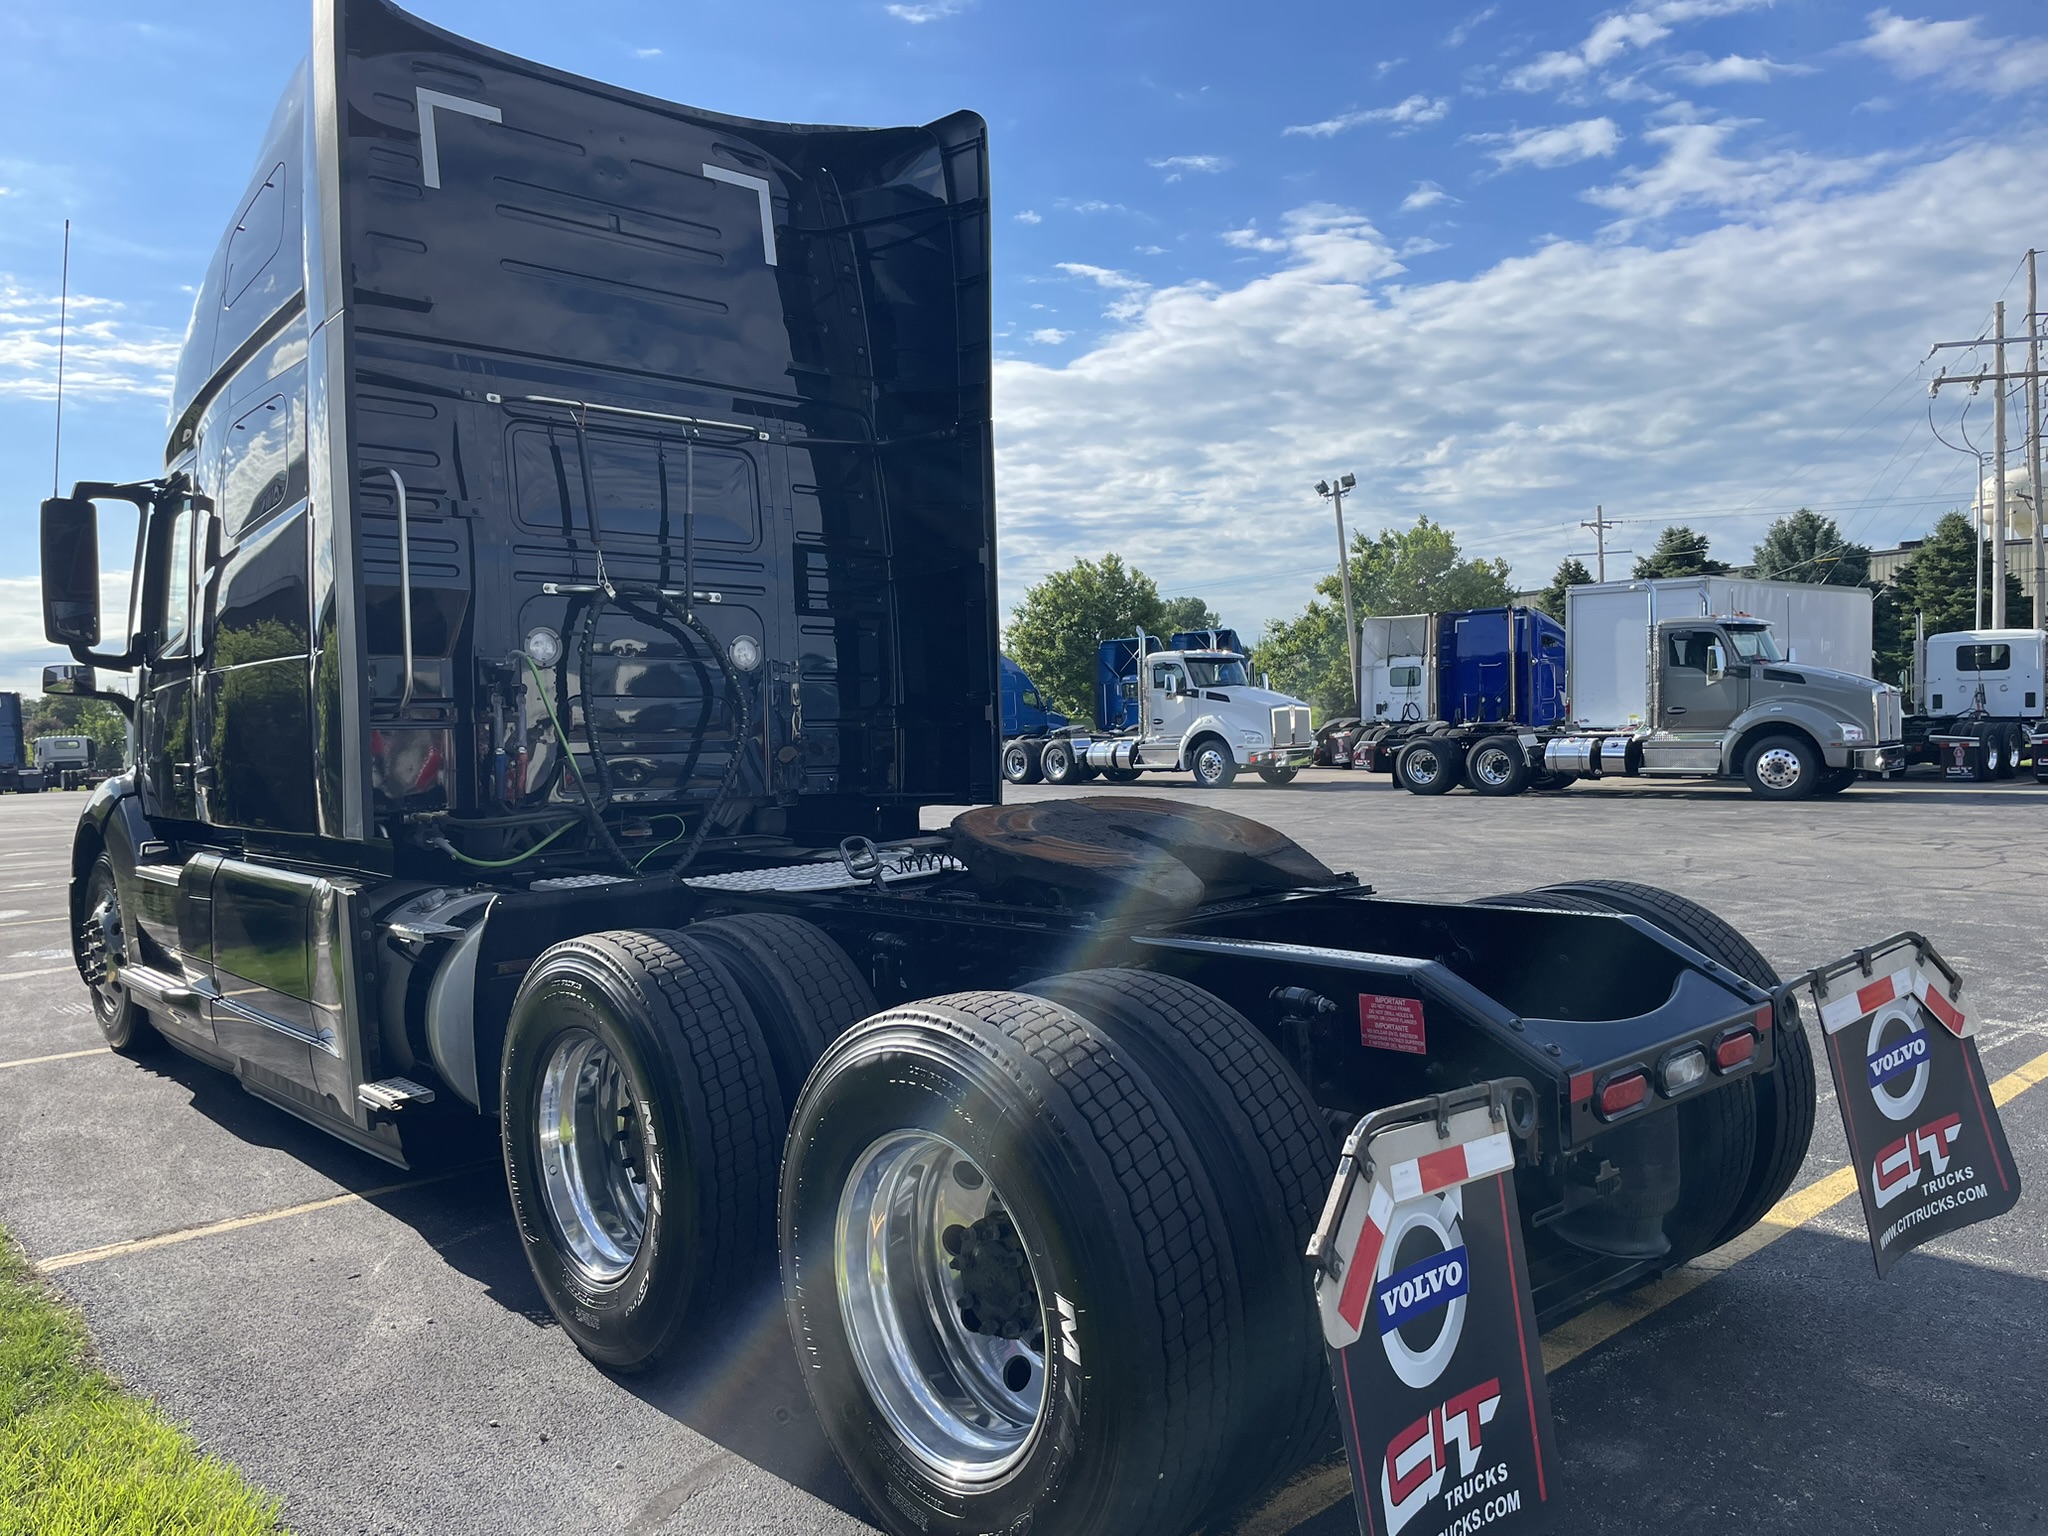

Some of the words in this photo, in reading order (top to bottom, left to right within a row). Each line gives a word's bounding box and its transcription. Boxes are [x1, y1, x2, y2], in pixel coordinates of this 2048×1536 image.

[1375, 997, 1405, 1006] IMPORTANT
[1375, 1022, 1409, 1032] IMPORTANTE
[1870, 1038, 1926, 1077] VOLVO
[1872, 1112, 1962, 1209] CIT
[1921, 1166, 1975, 1196] TRUCKS
[1879, 1183, 1988, 1250] WWW.CITTRUCKS.COM
[1380, 1261, 1463, 1316] VOLVO
[1380, 1377, 1501, 1536] CIT
[1444, 1462, 1509, 1511] TRUCKS
